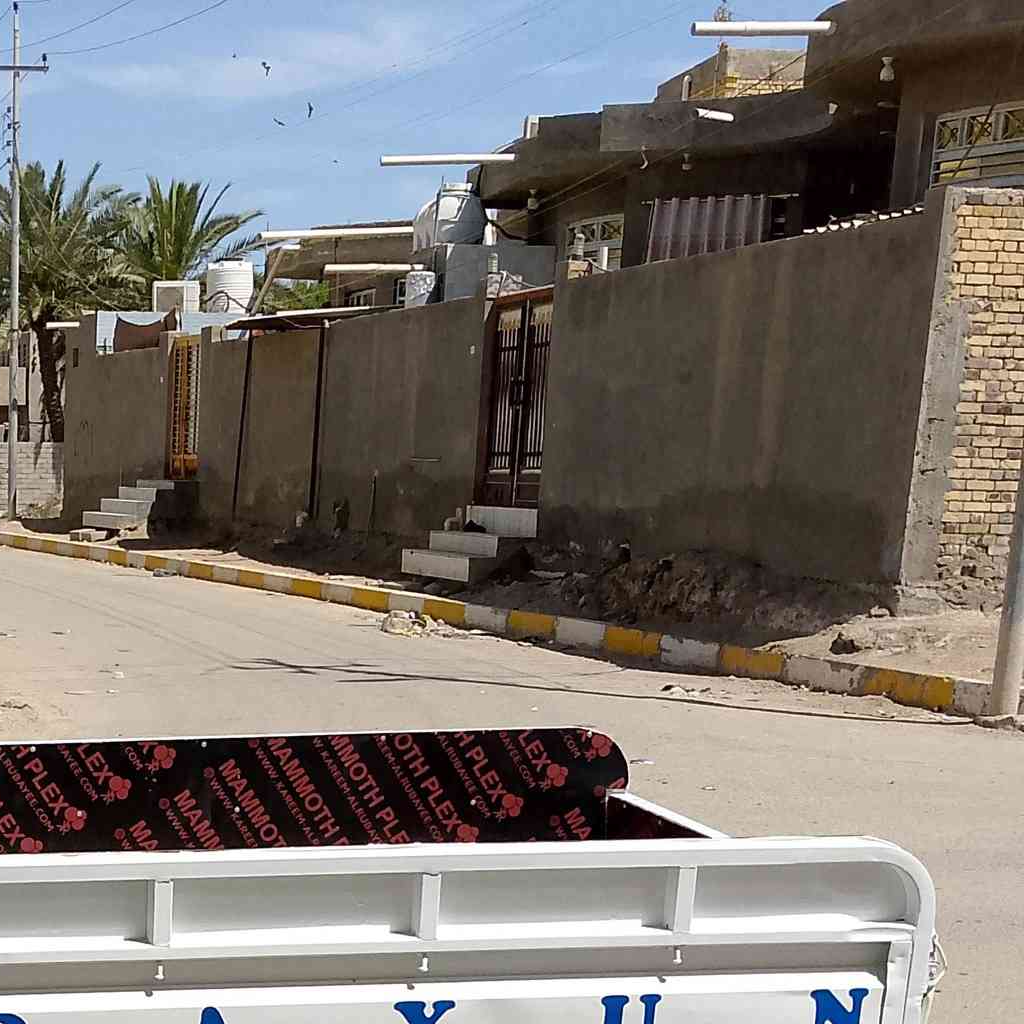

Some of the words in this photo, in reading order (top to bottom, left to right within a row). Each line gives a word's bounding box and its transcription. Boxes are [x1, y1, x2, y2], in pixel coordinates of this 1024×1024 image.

[24, 757, 69, 816] PLEX
[465, 745, 507, 803] PLEX
[420, 775, 463, 832] PLEX
